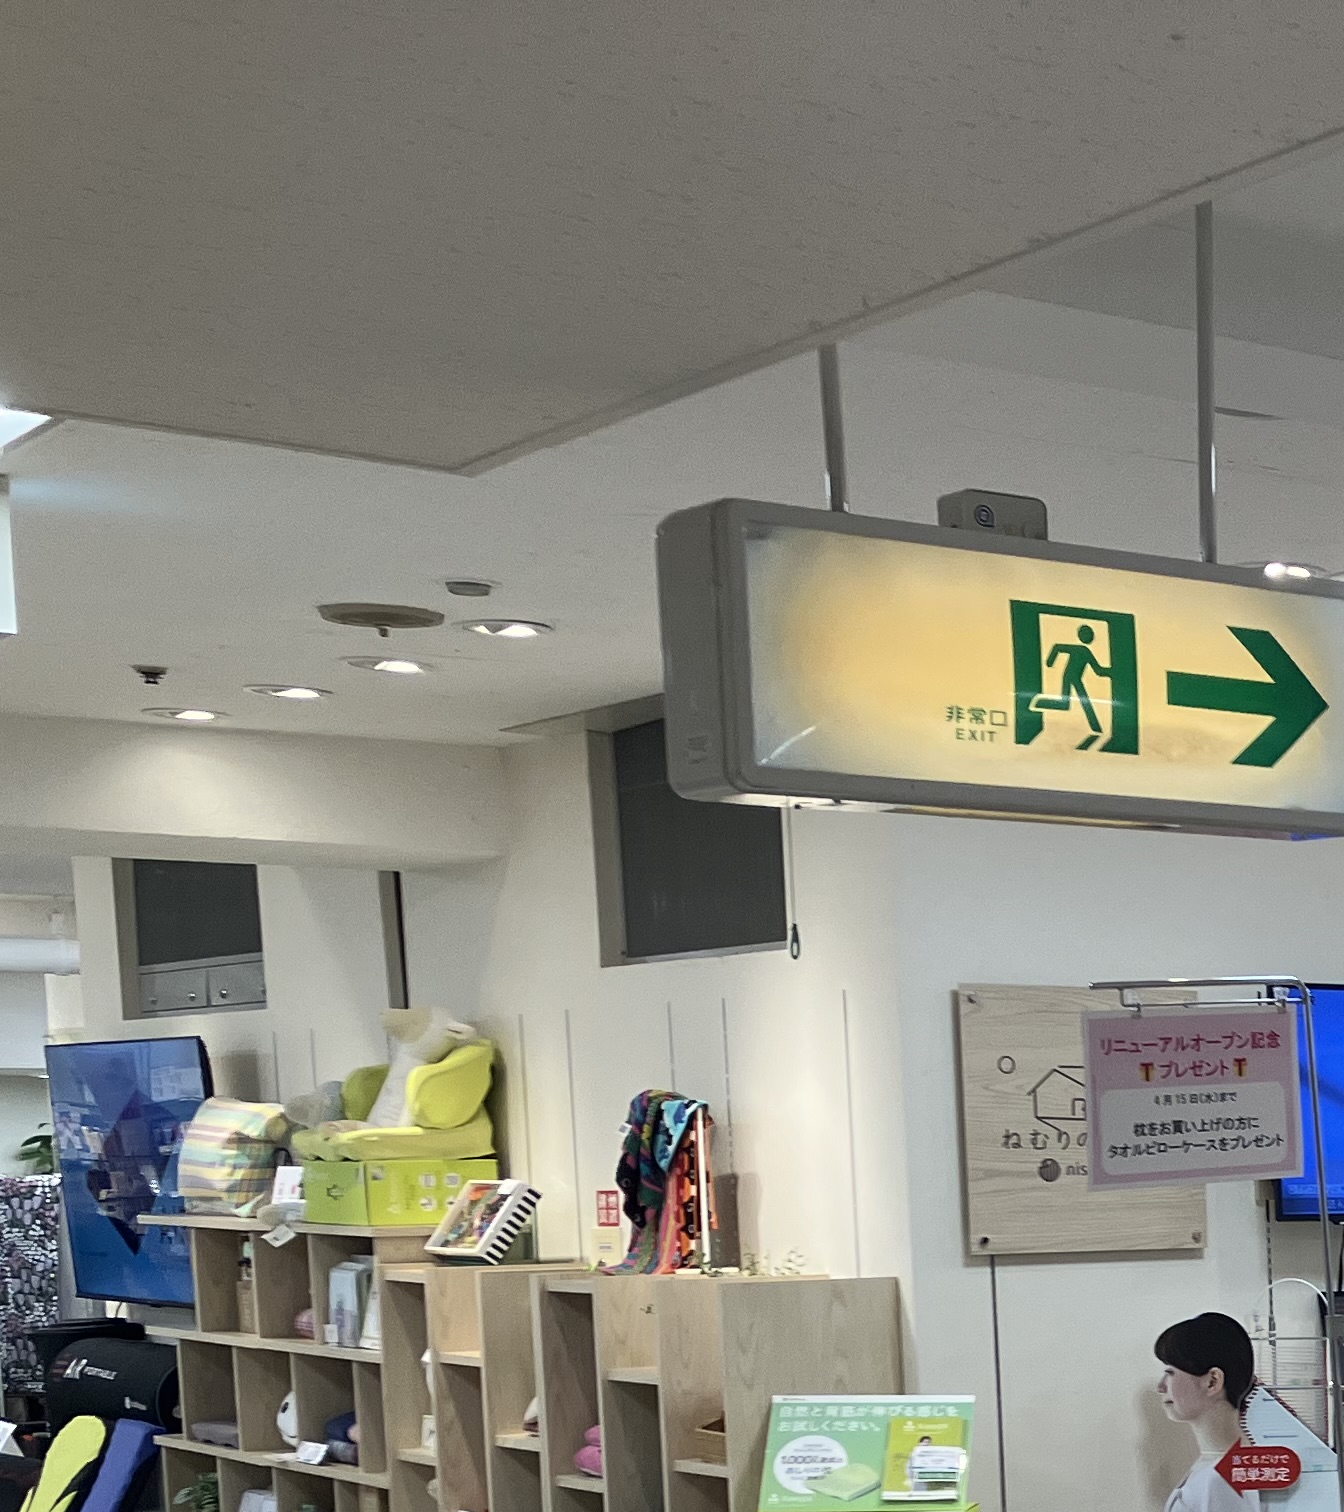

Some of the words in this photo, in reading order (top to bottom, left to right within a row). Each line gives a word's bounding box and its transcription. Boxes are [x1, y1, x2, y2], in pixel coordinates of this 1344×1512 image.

[945, 705, 1008, 727] 非常口
[955, 728, 997, 742] EXIT
[1101, 1030, 1281, 1056] リニューアルオープン記念
[1158, 1060, 1230, 1079] プレゼント
[1132, 1116, 1260, 1138] 枕をお買い上げの方に
[1107, 1133, 1285, 1159] タオルピローケースをプレゼント
[1231, 1454, 1290, 1465] 当てるだけで
[1231, 1467, 1291, 1482] 簡単測定
